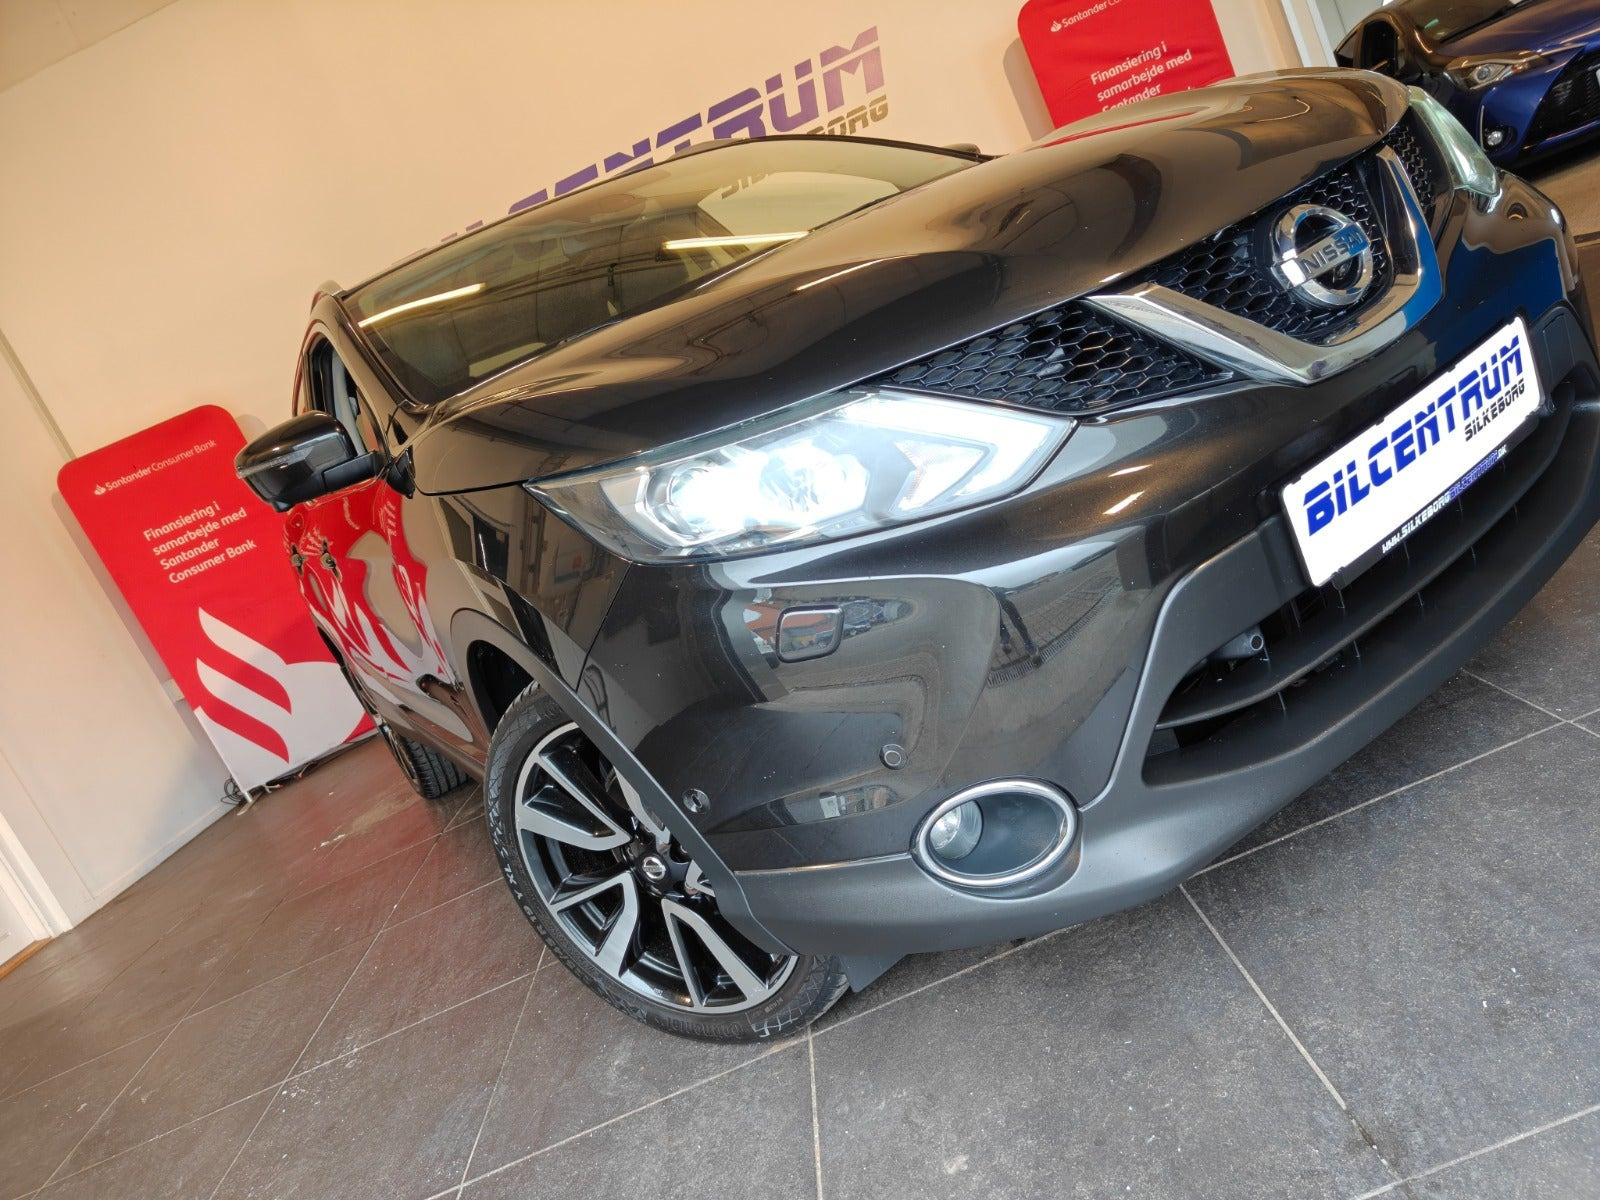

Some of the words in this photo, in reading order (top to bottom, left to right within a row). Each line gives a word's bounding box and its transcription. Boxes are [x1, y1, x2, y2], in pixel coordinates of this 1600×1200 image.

[1062, 1, 1107, 28] Santander
[1090, 45, 1161, 86] Finansiering
[1161, 41, 1168, 53] i
[1097, 63, 1164, 102] samarbejde
[1165, 49, 1193, 70] med
[1301, 230, 1364, 275] NISSAN
[1464, 378, 1525, 442] SILKEBORG
[1303, 335, 1523, 537] BILCENTRUM
[105, 465, 151, 491] Santander
[150, 449, 194, 472] Consumer
[193, 439, 216, 455] Bank
[143, 505, 215, 541] Finansiering
[213, 501, 220, 511] i
[153, 520, 220, 556] samarbejde
[221, 507, 247, 527] med
[160, 537, 220, 570] Santander
[169, 553, 227, 583] Consumer
[225, 539, 257, 559] Bank
